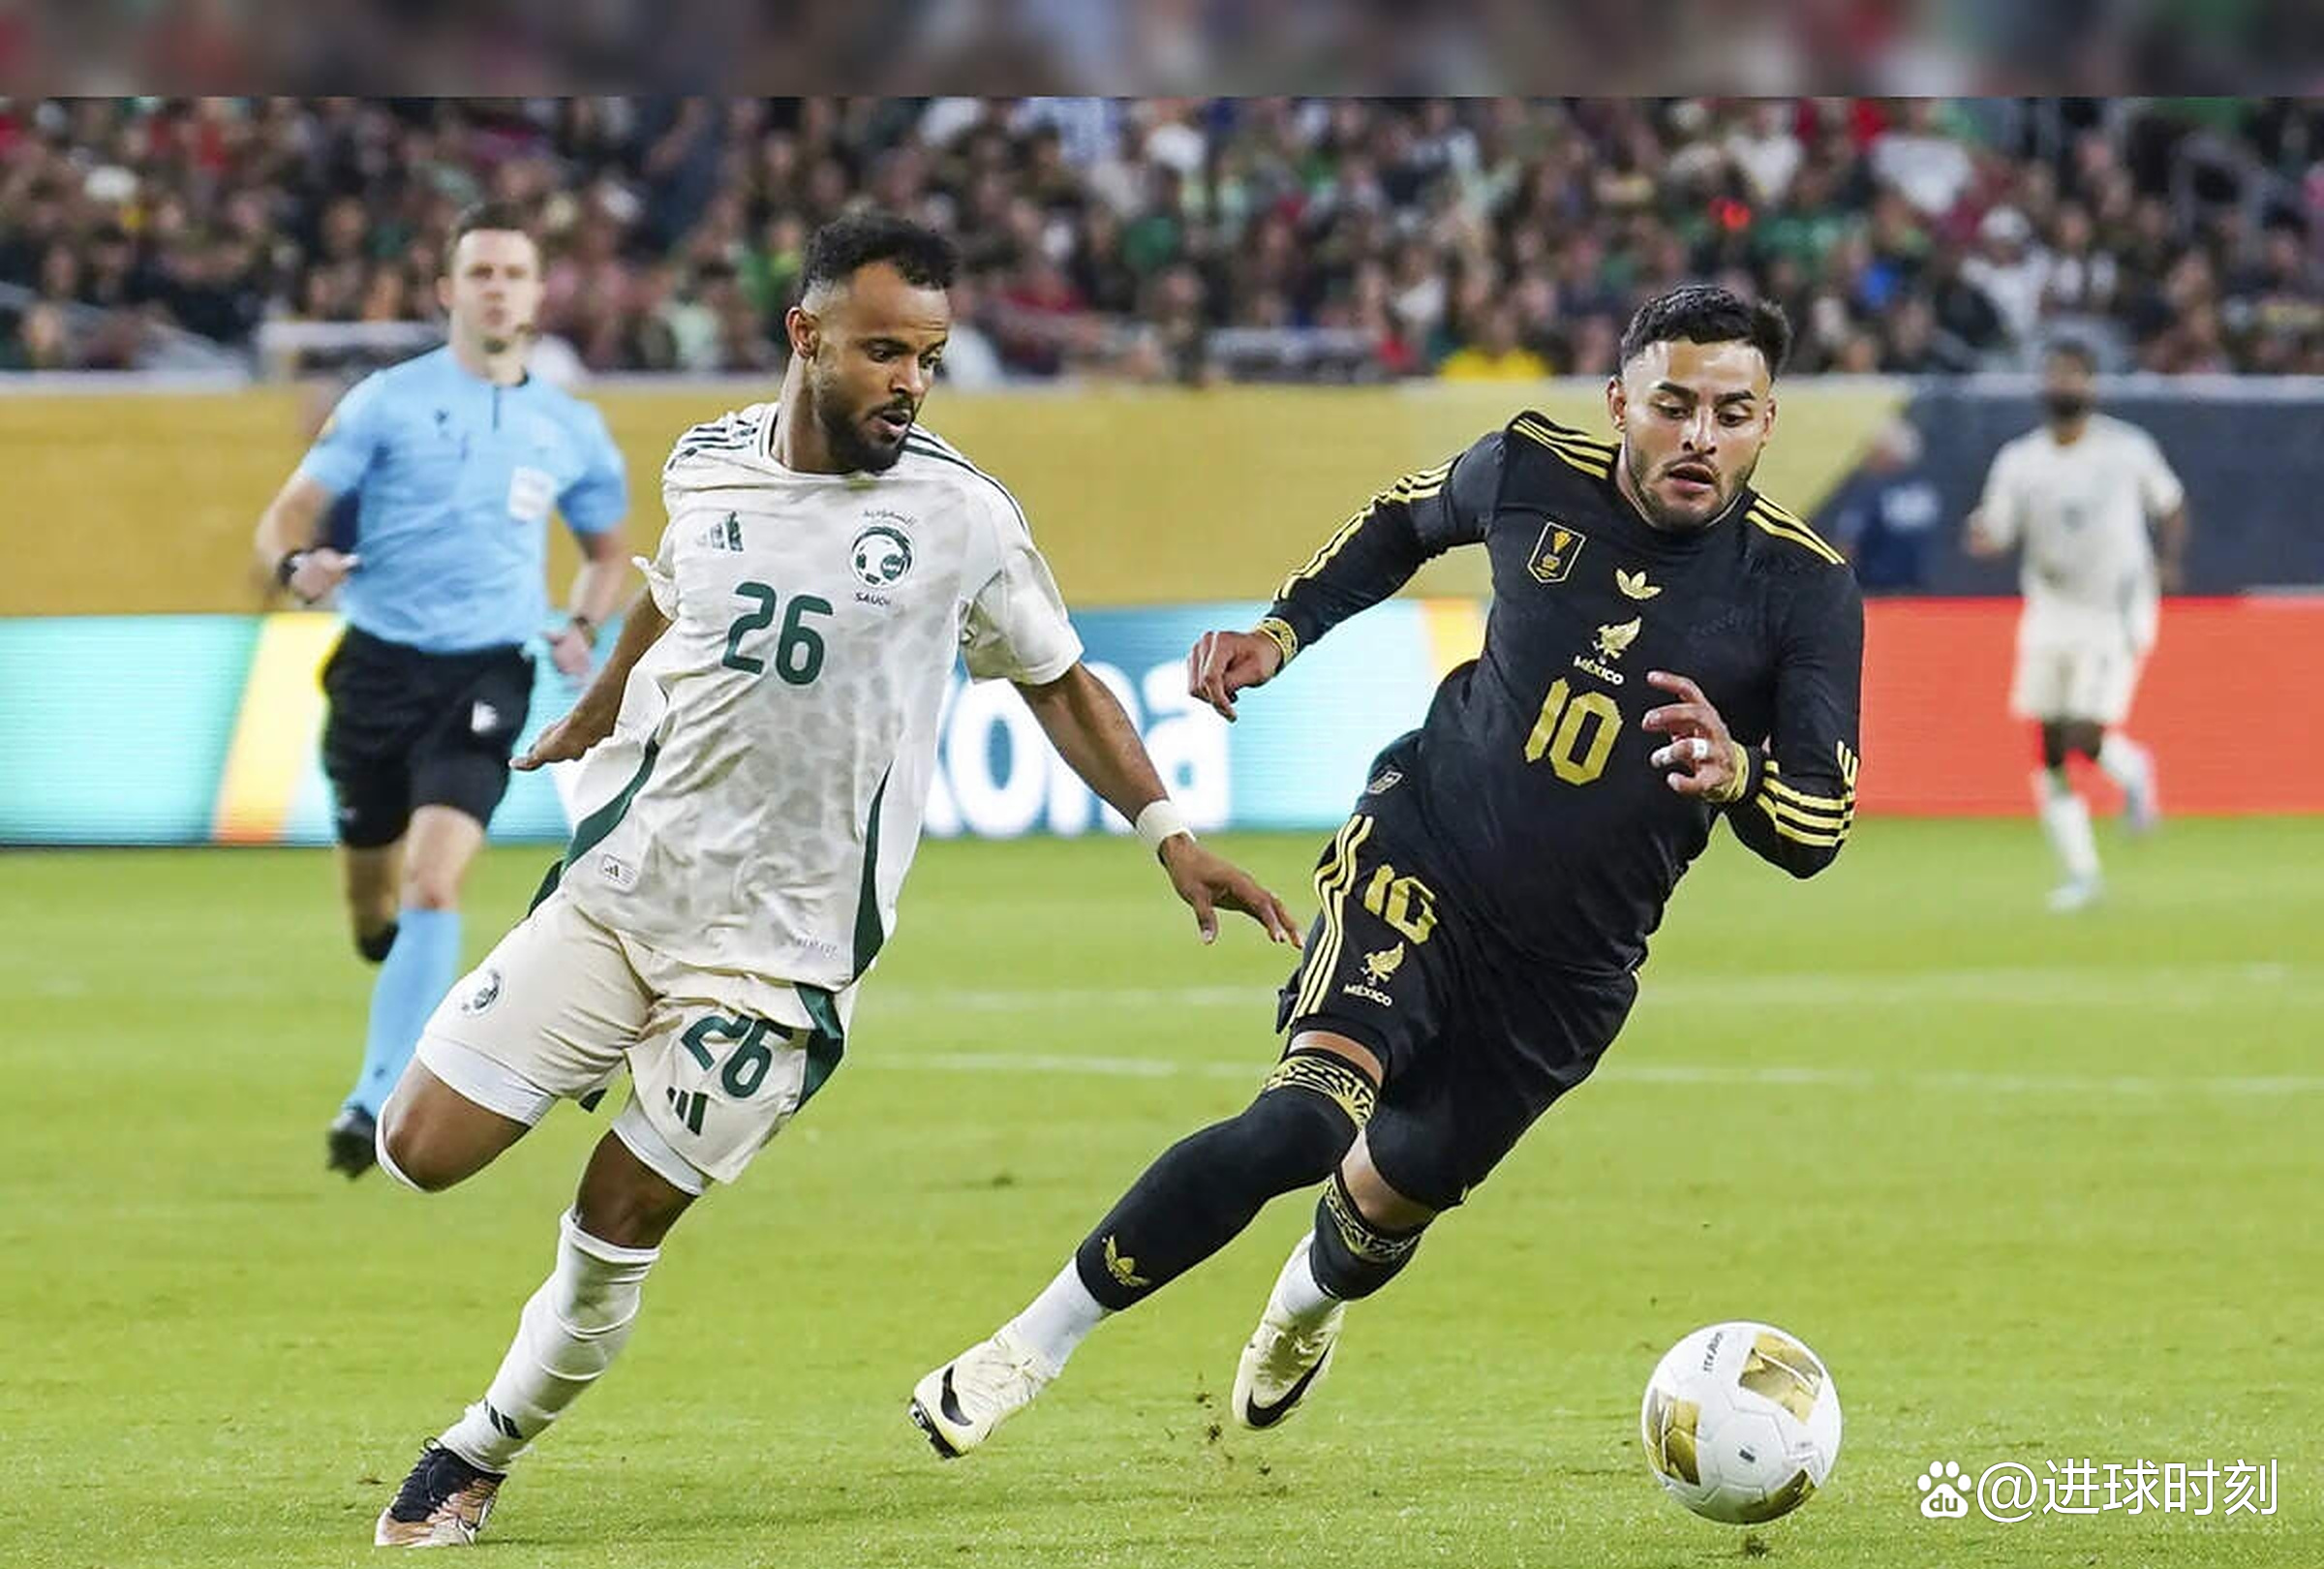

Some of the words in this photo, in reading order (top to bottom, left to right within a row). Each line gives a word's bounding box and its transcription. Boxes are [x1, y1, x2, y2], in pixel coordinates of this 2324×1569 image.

[721, 581, 833, 685] 26
[922, 660, 1229, 838] ona
[1524, 677, 1623, 786] 10
[1363, 864, 1438, 945] 10
[680, 1013, 792, 1098] 26
